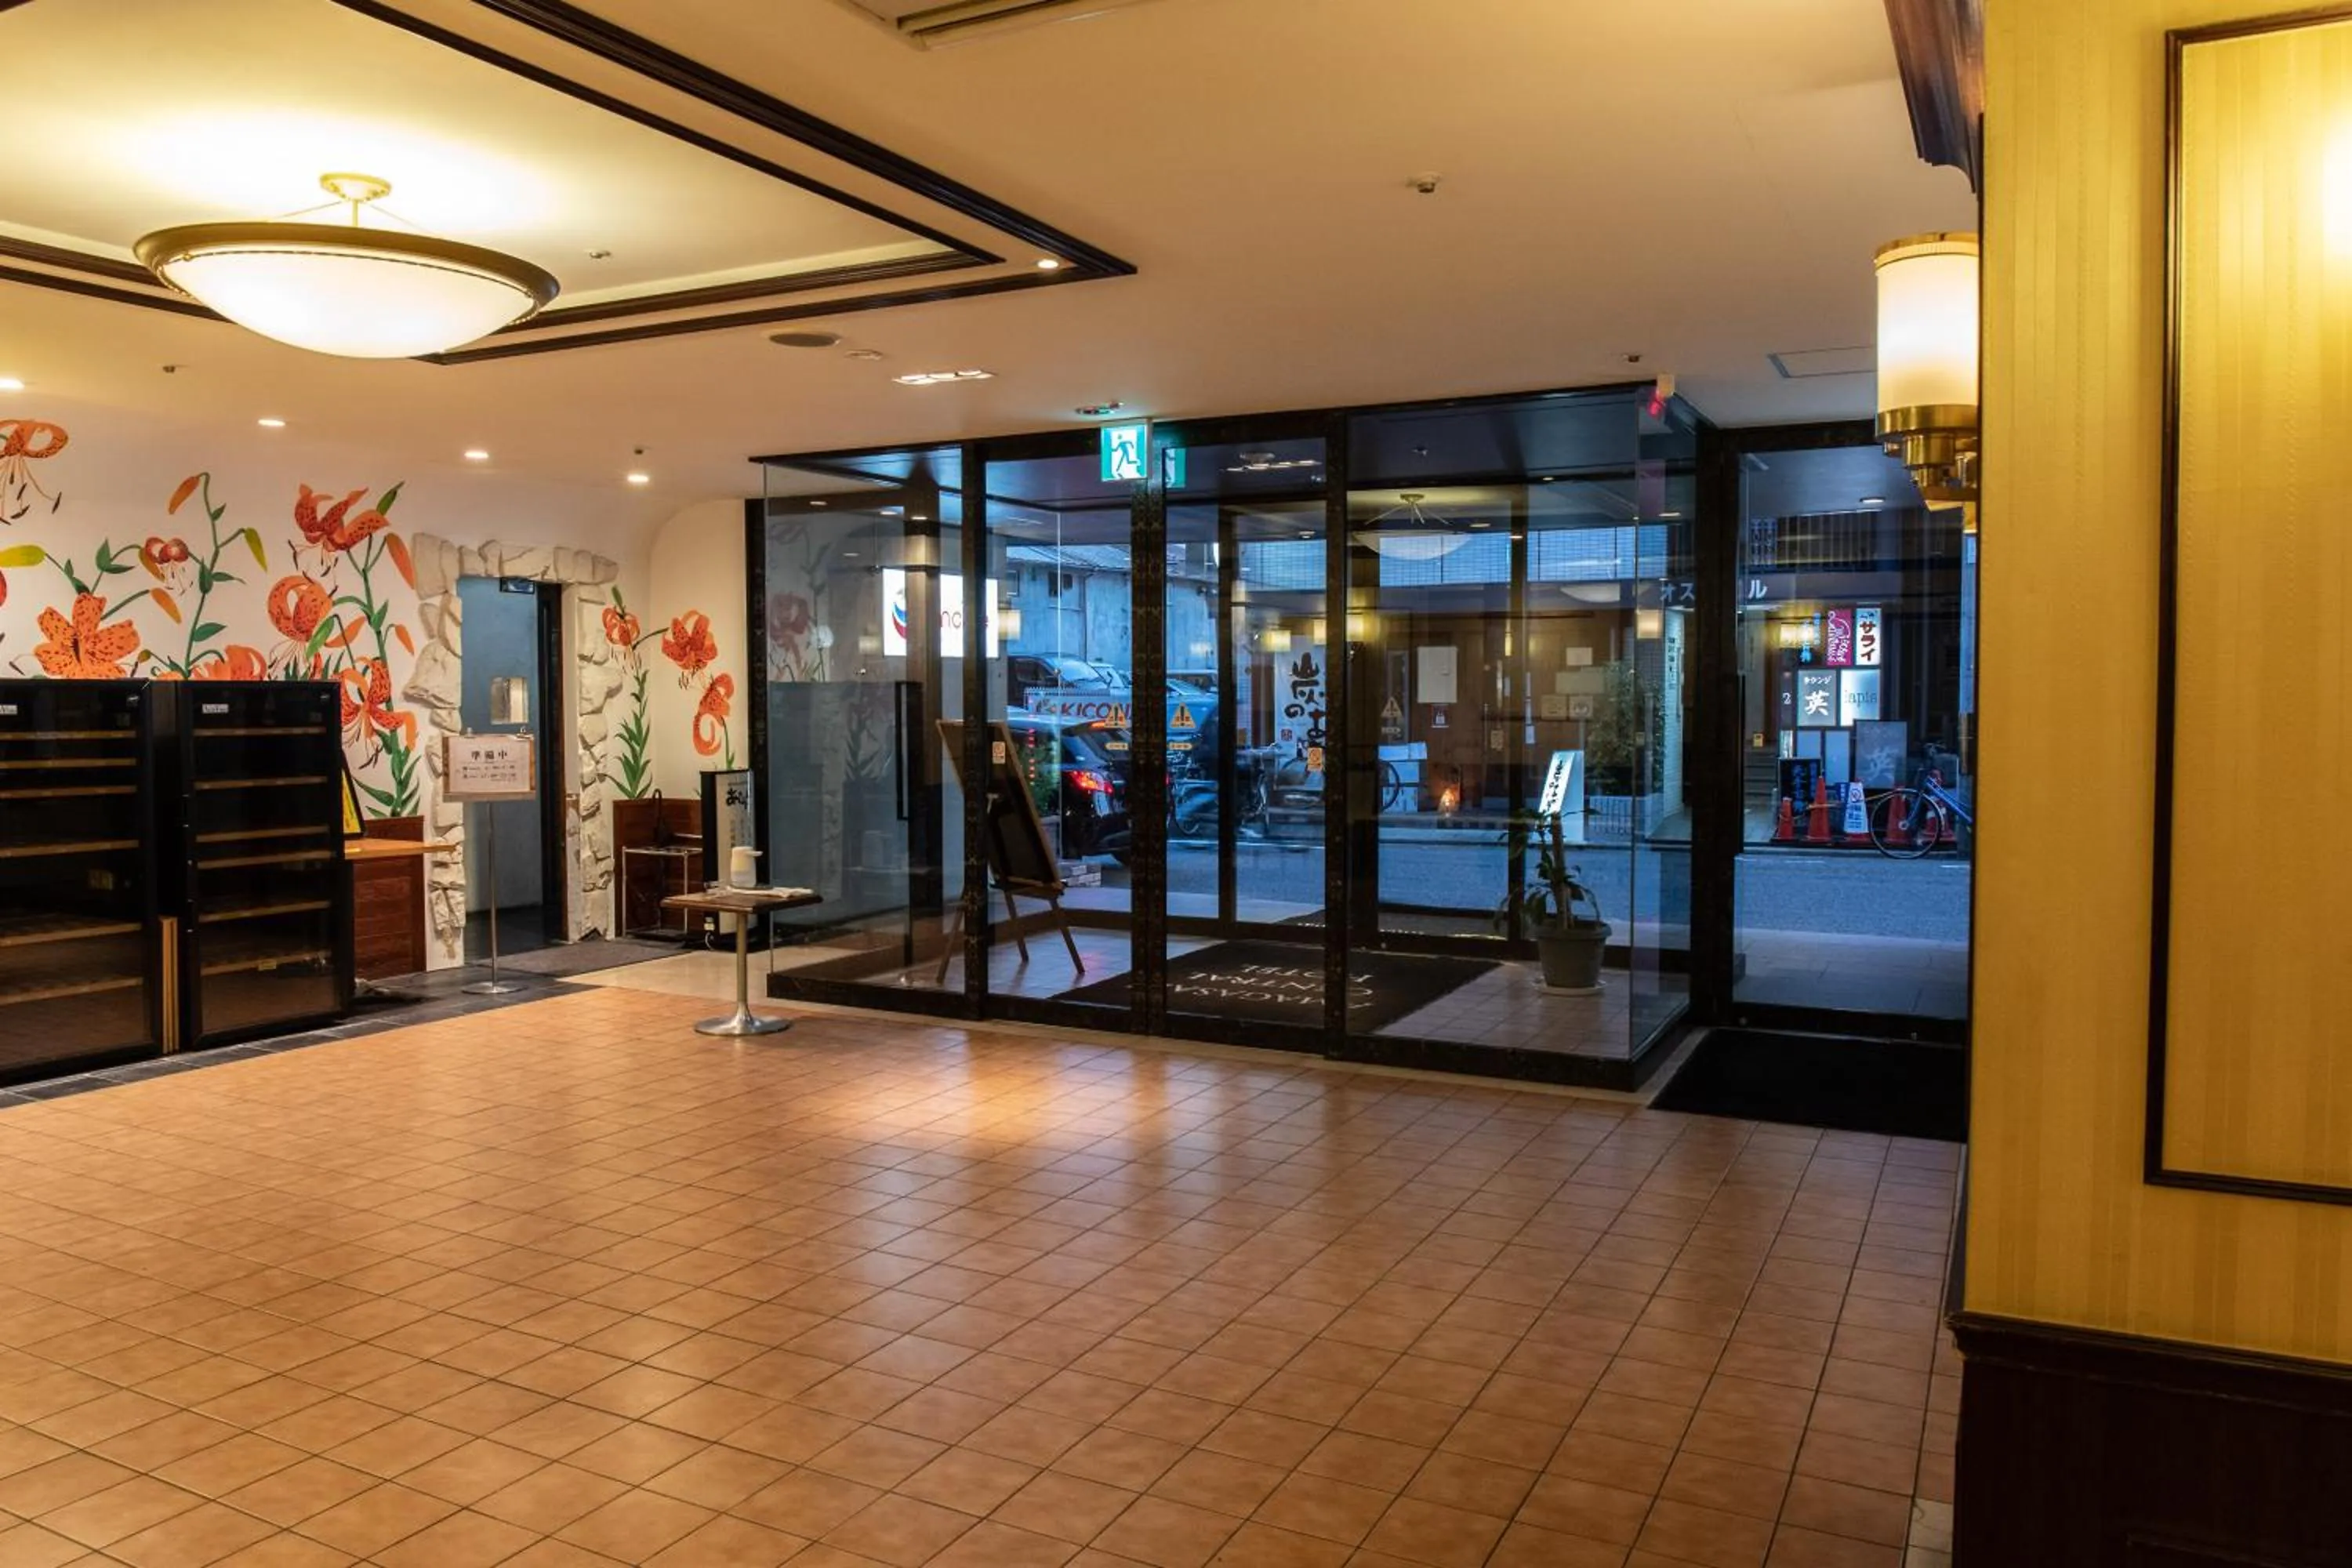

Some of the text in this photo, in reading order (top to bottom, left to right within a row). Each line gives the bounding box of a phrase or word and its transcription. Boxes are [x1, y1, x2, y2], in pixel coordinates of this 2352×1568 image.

[1859, 621, 1877, 662] サライ
[1804, 689, 1830, 717] 英
